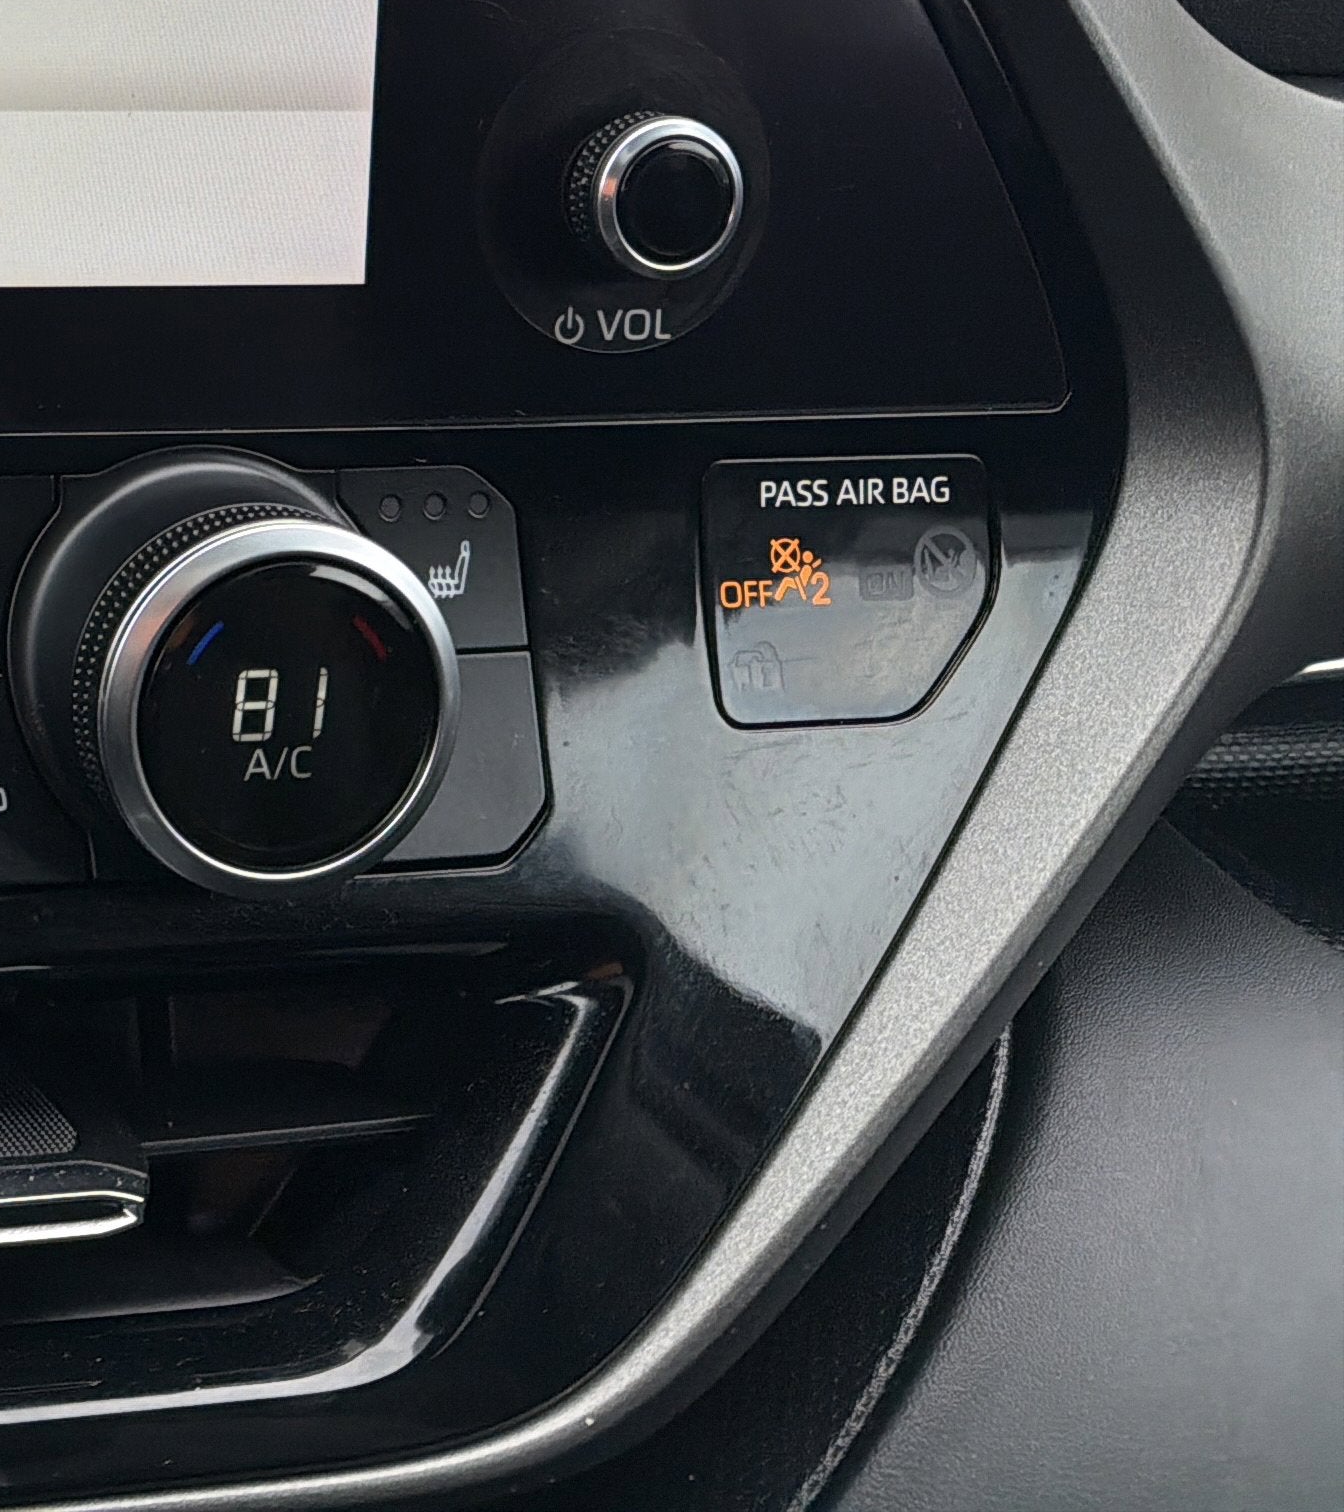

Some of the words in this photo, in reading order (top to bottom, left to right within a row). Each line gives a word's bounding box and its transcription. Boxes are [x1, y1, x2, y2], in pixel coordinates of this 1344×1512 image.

[598, 309, 671, 340] VOL
[761, 480, 828, 507] PASS
[837, 478, 884, 505] AIR
[893, 476, 949, 503] BAG
[719, 580, 773, 609] OFF
[233, 668, 327, 741] 81
[245, 746, 311, 780] A/C
